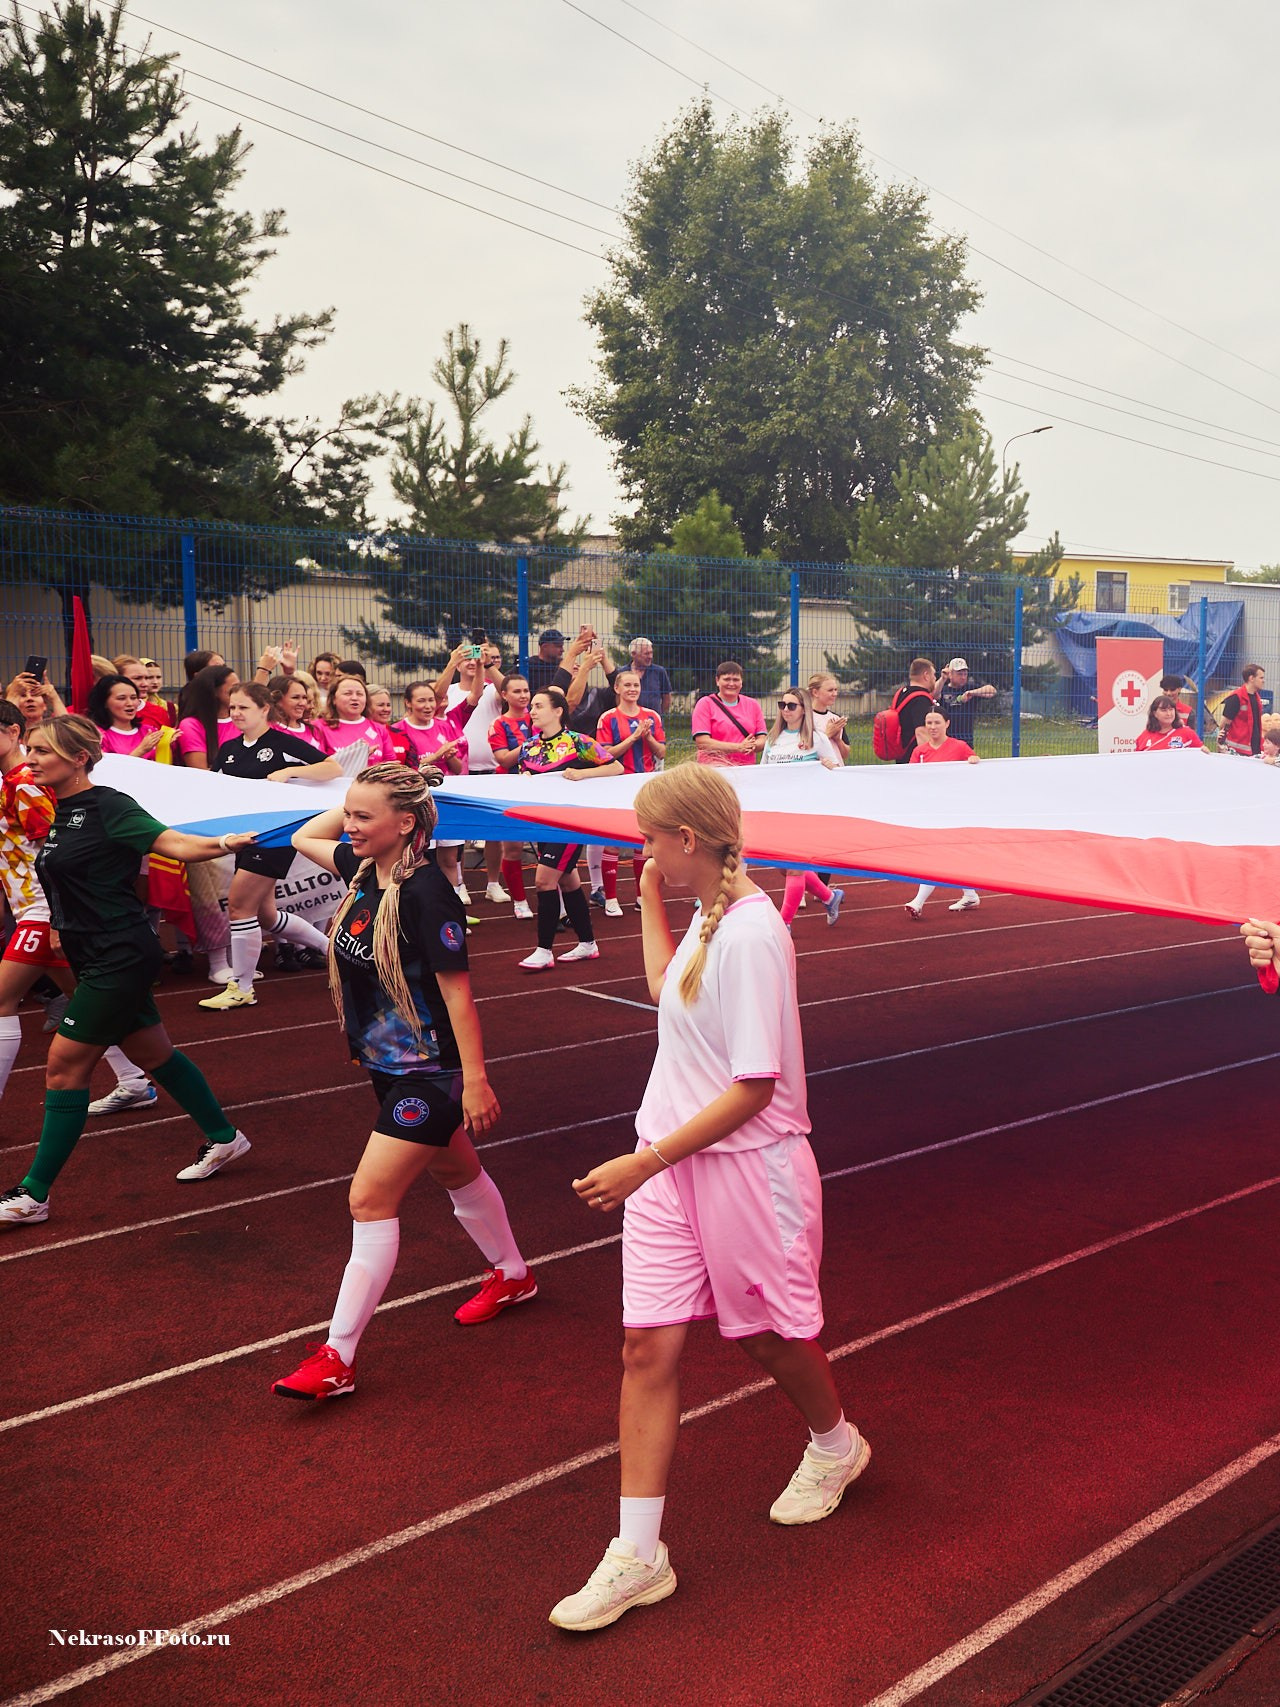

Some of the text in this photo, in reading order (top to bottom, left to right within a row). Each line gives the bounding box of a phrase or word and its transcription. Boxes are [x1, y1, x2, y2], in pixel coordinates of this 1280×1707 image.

[274, 872, 342, 900] ELLTO
[277, 891, 342, 913] БОКСАРЫ
[13, 928, 43, 953] 15
